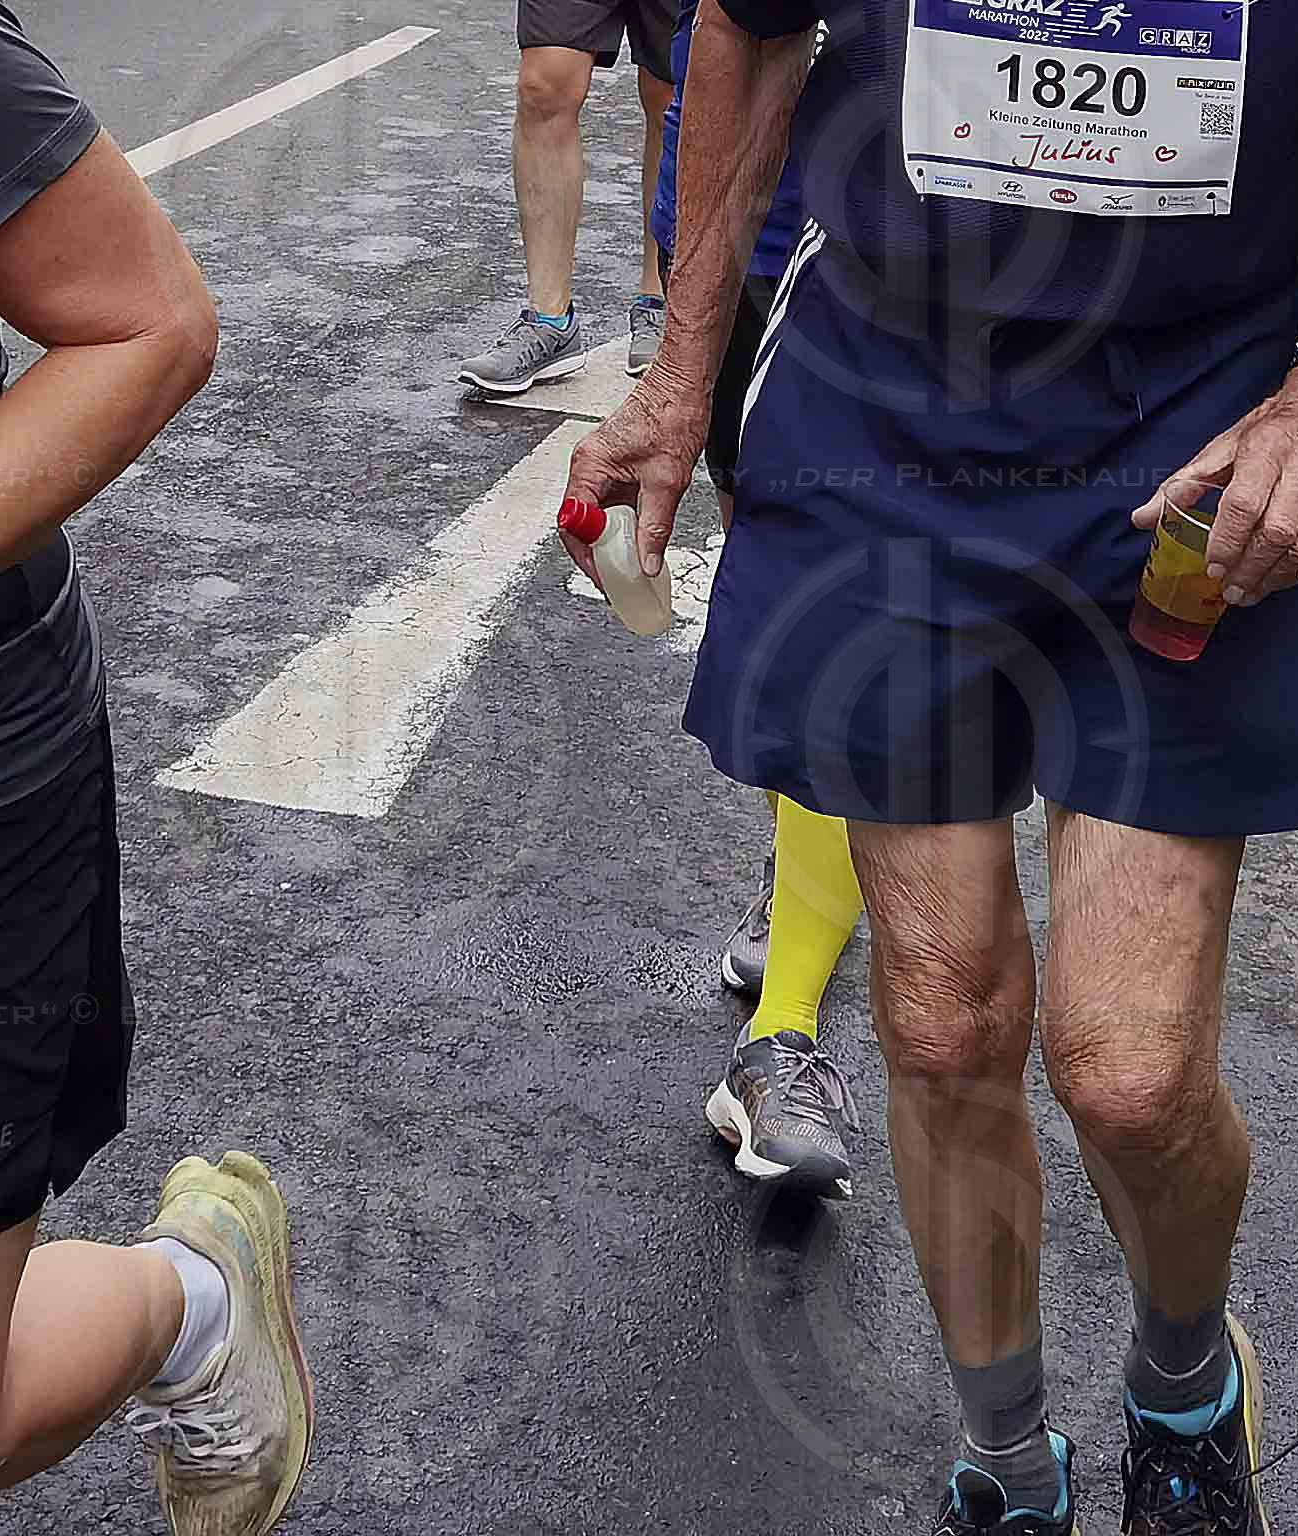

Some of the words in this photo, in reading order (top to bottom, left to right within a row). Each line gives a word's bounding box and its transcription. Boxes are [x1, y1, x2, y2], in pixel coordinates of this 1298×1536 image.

[968, 7, 1040, 28] MARATHON
[1019, 28, 1050, 42] 2022
[1141, 29, 1209, 46] GRAZ
[997, 53, 1147, 117] 1820
[989, 109, 1028, 126] Kleine
[1032, 116, 1082, 134] Zeitung
[1085, 122, 1148, 139] Marathon
[1011, 134, 1122, 169] Julius
